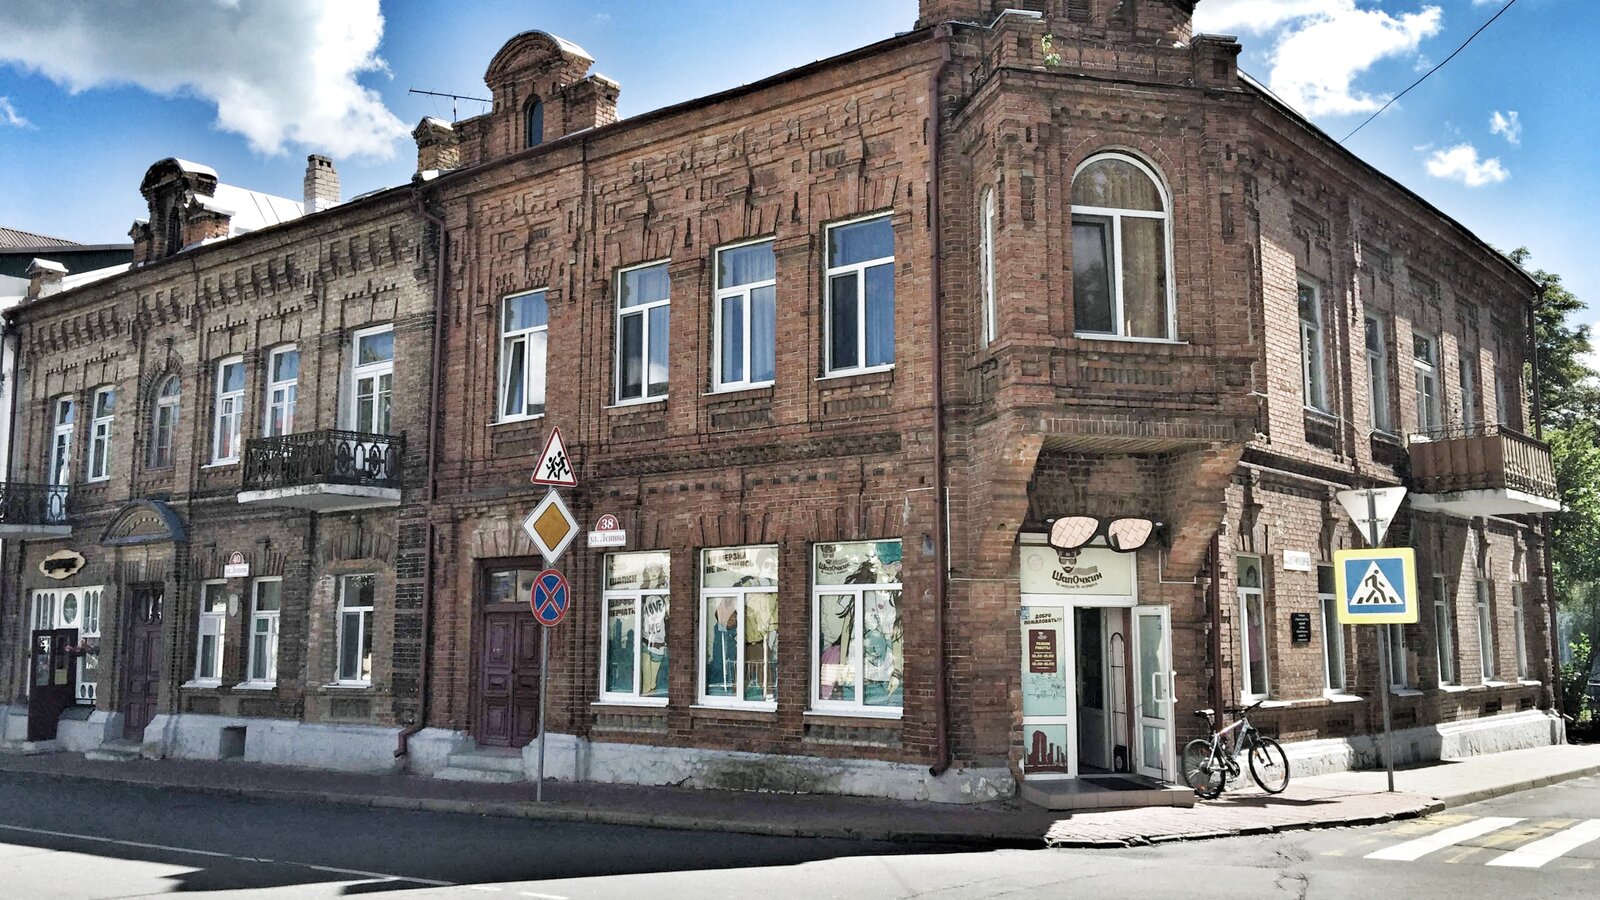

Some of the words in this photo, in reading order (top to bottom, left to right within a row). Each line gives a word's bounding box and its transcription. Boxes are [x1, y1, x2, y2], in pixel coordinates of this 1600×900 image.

[601, 518, 614, 530] 38
[233, 554, 241, 564] 40
[609, 574, 637, 586] ШАПКИ
[645, 599, 663, 617] LOVE
[648, 622, 661, 634] ME
